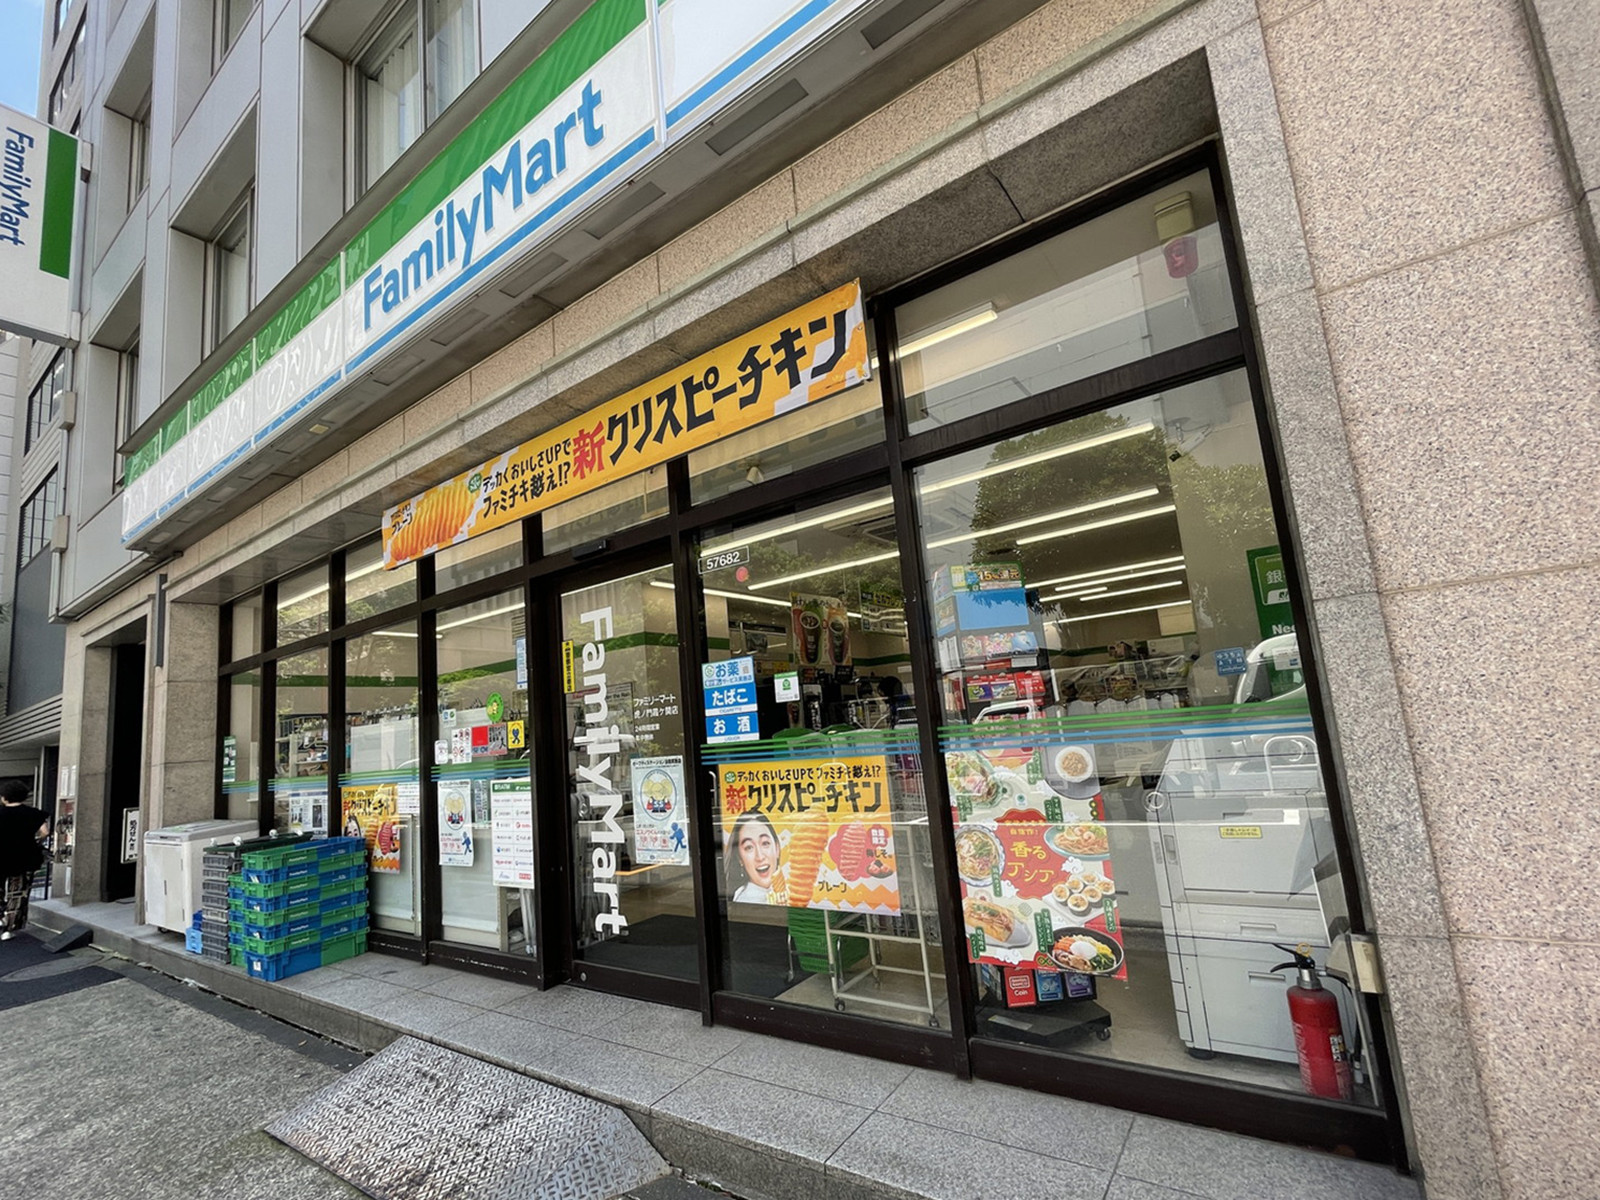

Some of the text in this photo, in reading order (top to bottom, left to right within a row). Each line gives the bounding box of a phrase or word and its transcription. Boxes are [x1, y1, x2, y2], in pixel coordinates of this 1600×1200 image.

[0, 126, 34, 246] FamilyMart
[363, 79, 605, 333] FamilyMart
[572, 310, 848, 480] 新クリスピーチキン
[482, 437, 571, 493] デッカくおいしさUPで
[706, 551, 741, 570] 57682
[715, 661, 740, 678] お薬
[633, 693, 676, 708] ファミリーマート
[712, 688, 749, 706] たばこ
[713, 715, 751, 735] お 酒
[580, 606, 628, 935] FamilyMart
[725, 780, 882, 815] 新クリスピーチキン
[1010, 840, 1047, 860] 香る
